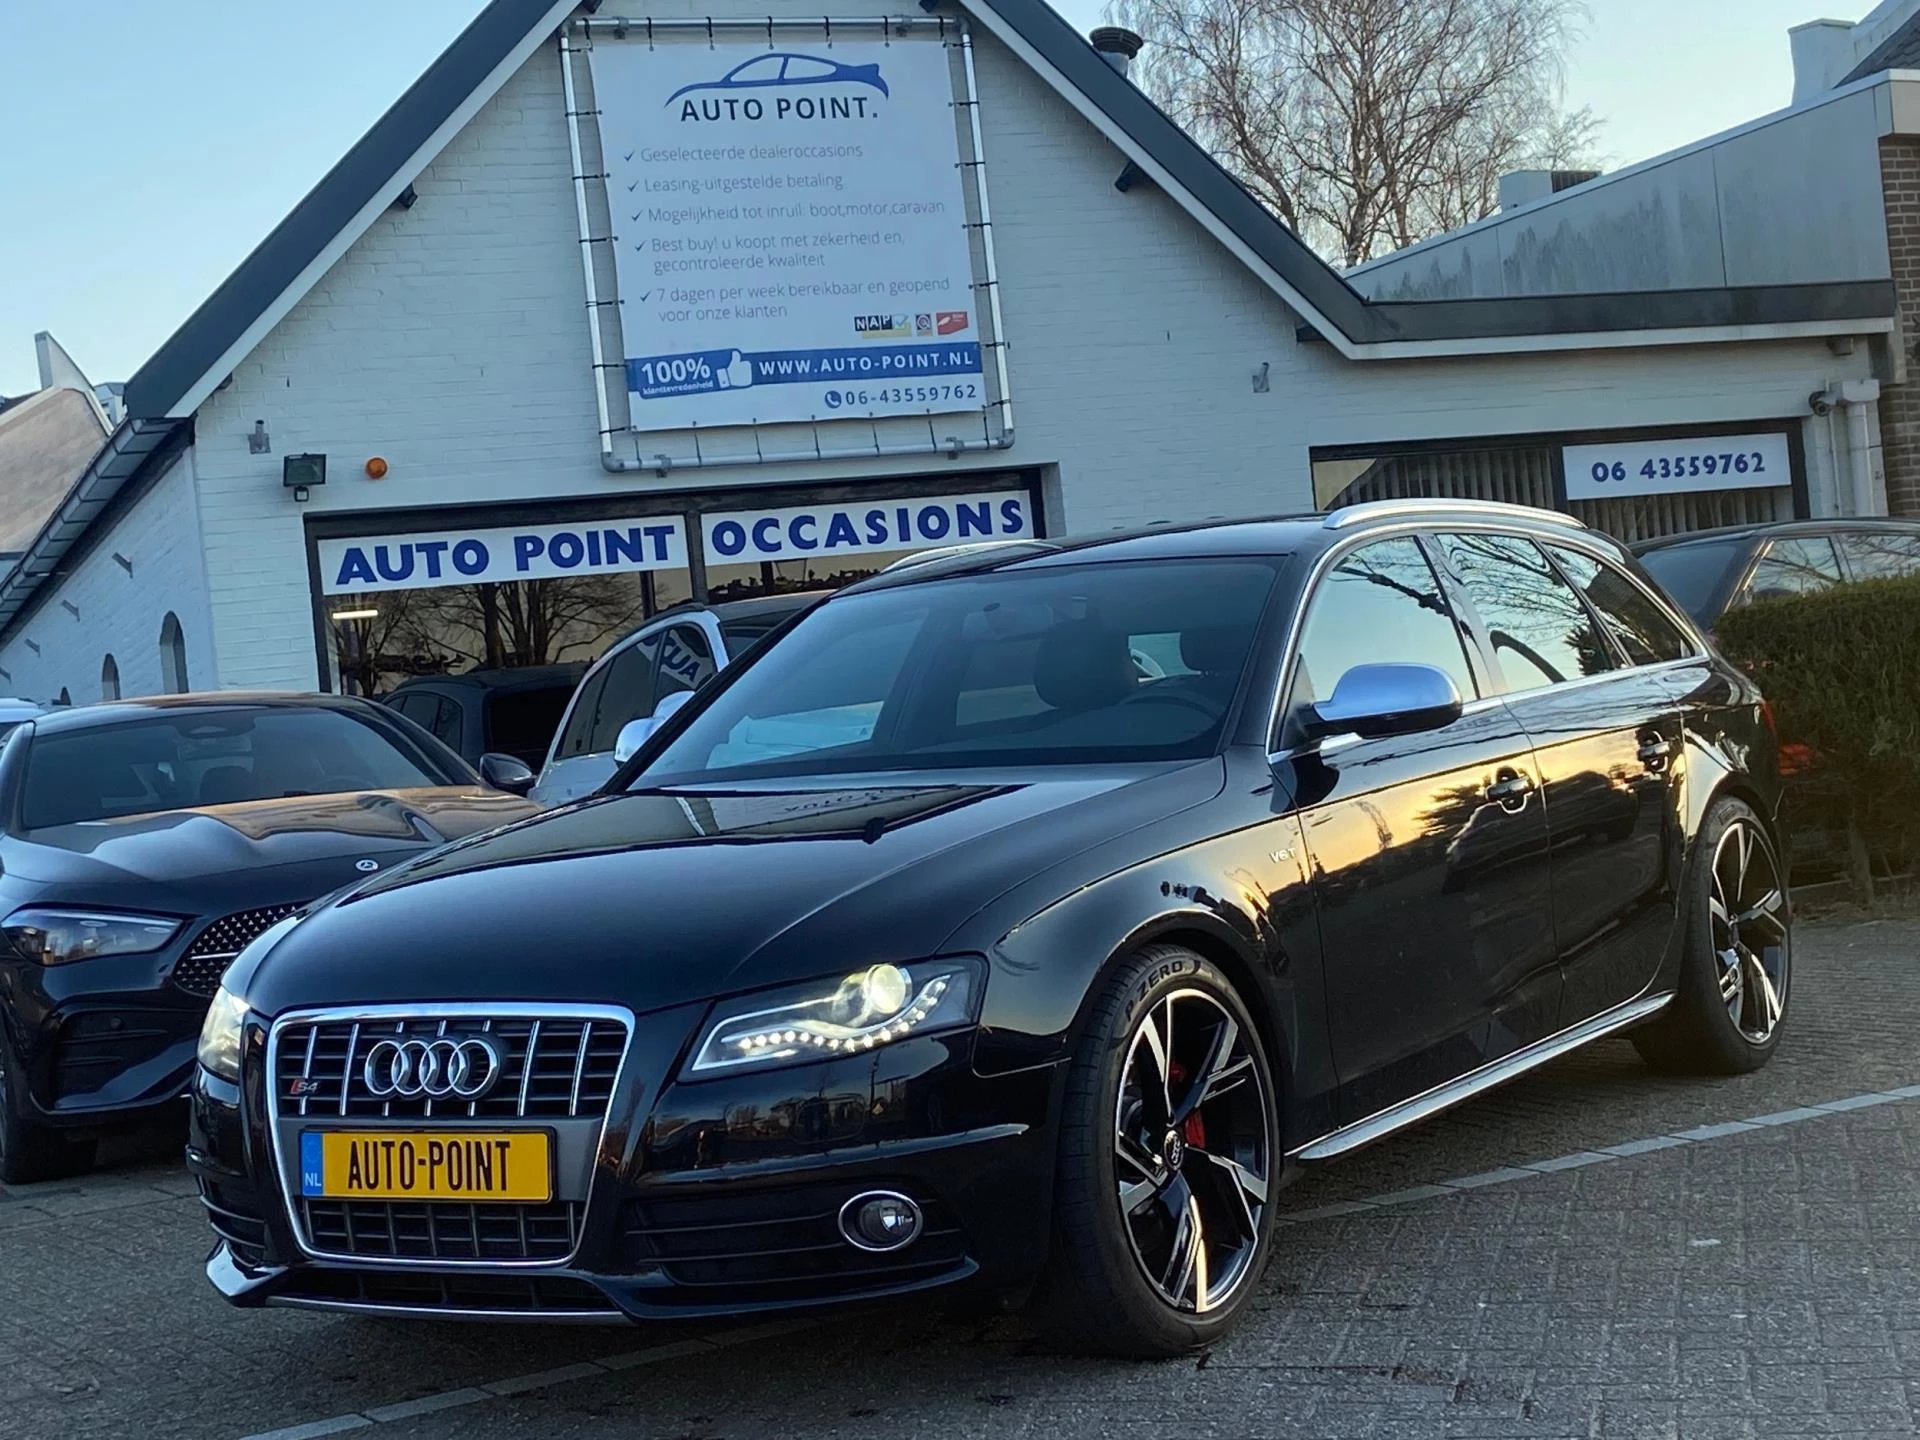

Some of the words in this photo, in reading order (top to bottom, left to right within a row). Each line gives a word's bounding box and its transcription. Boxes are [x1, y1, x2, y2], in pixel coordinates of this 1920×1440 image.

[681, 99, 763, 122] AUTO
[776, 97, 878, 120] POINT.
[640, 146, 745, 163] Geselecteerde
[750, 144, 863, 160] dealeroccasions
[644, 174, 783, 195] Leasing-uitgestelde
[786, 173, 844, 190] betaling
[648, 205, 739, 225] Mogelijkheid
[743, 206, 763, 219] tot
[651, 238, 684, 252] Best
[688, 236, 718, 254] buy!
[722, 240, 732, 250] u
[736, 235, 778, 251] koopt
[780, 234, 809, 248] met
[812, 231, 880, 247] zekerheid
[654, 255, 765, 277] gecontroleerde
[768, 252, 826, 268] kwaliteit
[657, 288, 666, 302] 7
[670, 287, 716, 305] dagen
[719, 287, 744, 303] per
[747, 283, 786, 298] week
[789, 280, 864, 297] bereikbaar
[868, 281, 885, 293] en
[889, 278, 950, 297] geopend
[658, 310, 692, 322] voor
[695, 307, 731, 321] onze
[735, 304, 788, 319] klanten
[854, 314, 892, 331] NAP
[641, 357, 711, 385] 100%
[759, 352, 973, 376] WWW.AUTO-POINT.NL
[846, 384, 976, 405] 06-43559762
[1591, 461, 1626, 482] 06
[1639, 452, 1765, 479] 43559762
[711, 499, 1024, 558] OCCASIONS
[336, 539, 490, 585] AUTO
[514, 525, 675, 572] POINT
[1137, 960, 1184, 1001] ZERO
[304, 1172, 322, 1187] NL
[348, 1140, 511, 1192] AUTO-POINT
